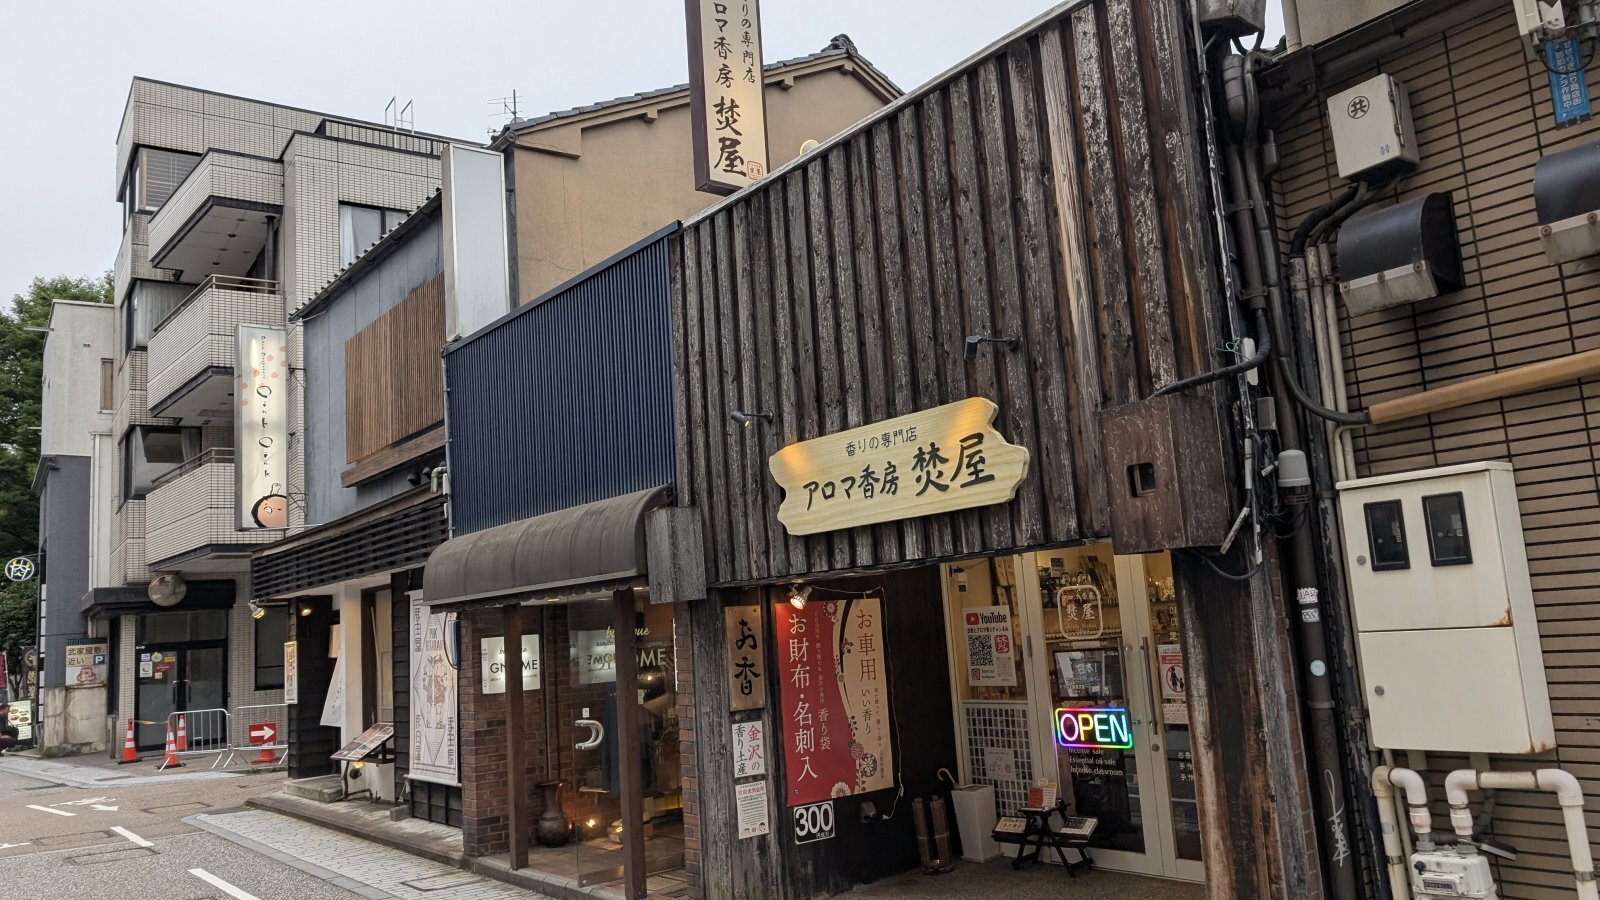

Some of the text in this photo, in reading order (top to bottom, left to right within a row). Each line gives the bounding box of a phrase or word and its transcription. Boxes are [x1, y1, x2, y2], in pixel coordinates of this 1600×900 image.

[741, 0, 756, 84] りの専門店
[1350, 98, 1367, 117] 共
[713, 95, 747, 178] 焚屋
[845, 426, 918, 457] 香りの専門店
[802, 432, 995, 511] アロマ香房 焚屋
[979, 612, 1007, 624] YouTube
[1066, 603, 1096, 621] 焚屋
[67, 657, 85, 666] 近い
[95, 655, 104, 664] P
[735, 618, 761, 696] お香
[856, 609, 877, 682] お車用
[490, 659, 538, 674] GNME
[788, 613, 819, 782] お財布・名刺入
[861, 688, 873, 735] いい香り
[818, 707, 831, 751] 香り袋
[1059, 713, 1128, 743] OPEN
[734, 723, 748, 776] 香り土産
[747, 723, 764, 771] 金沢の
[1069, 755, 1094, 764] Essential
[1094, 767, 1123, 776] classroom
[795, 803, 833, 836] 300
